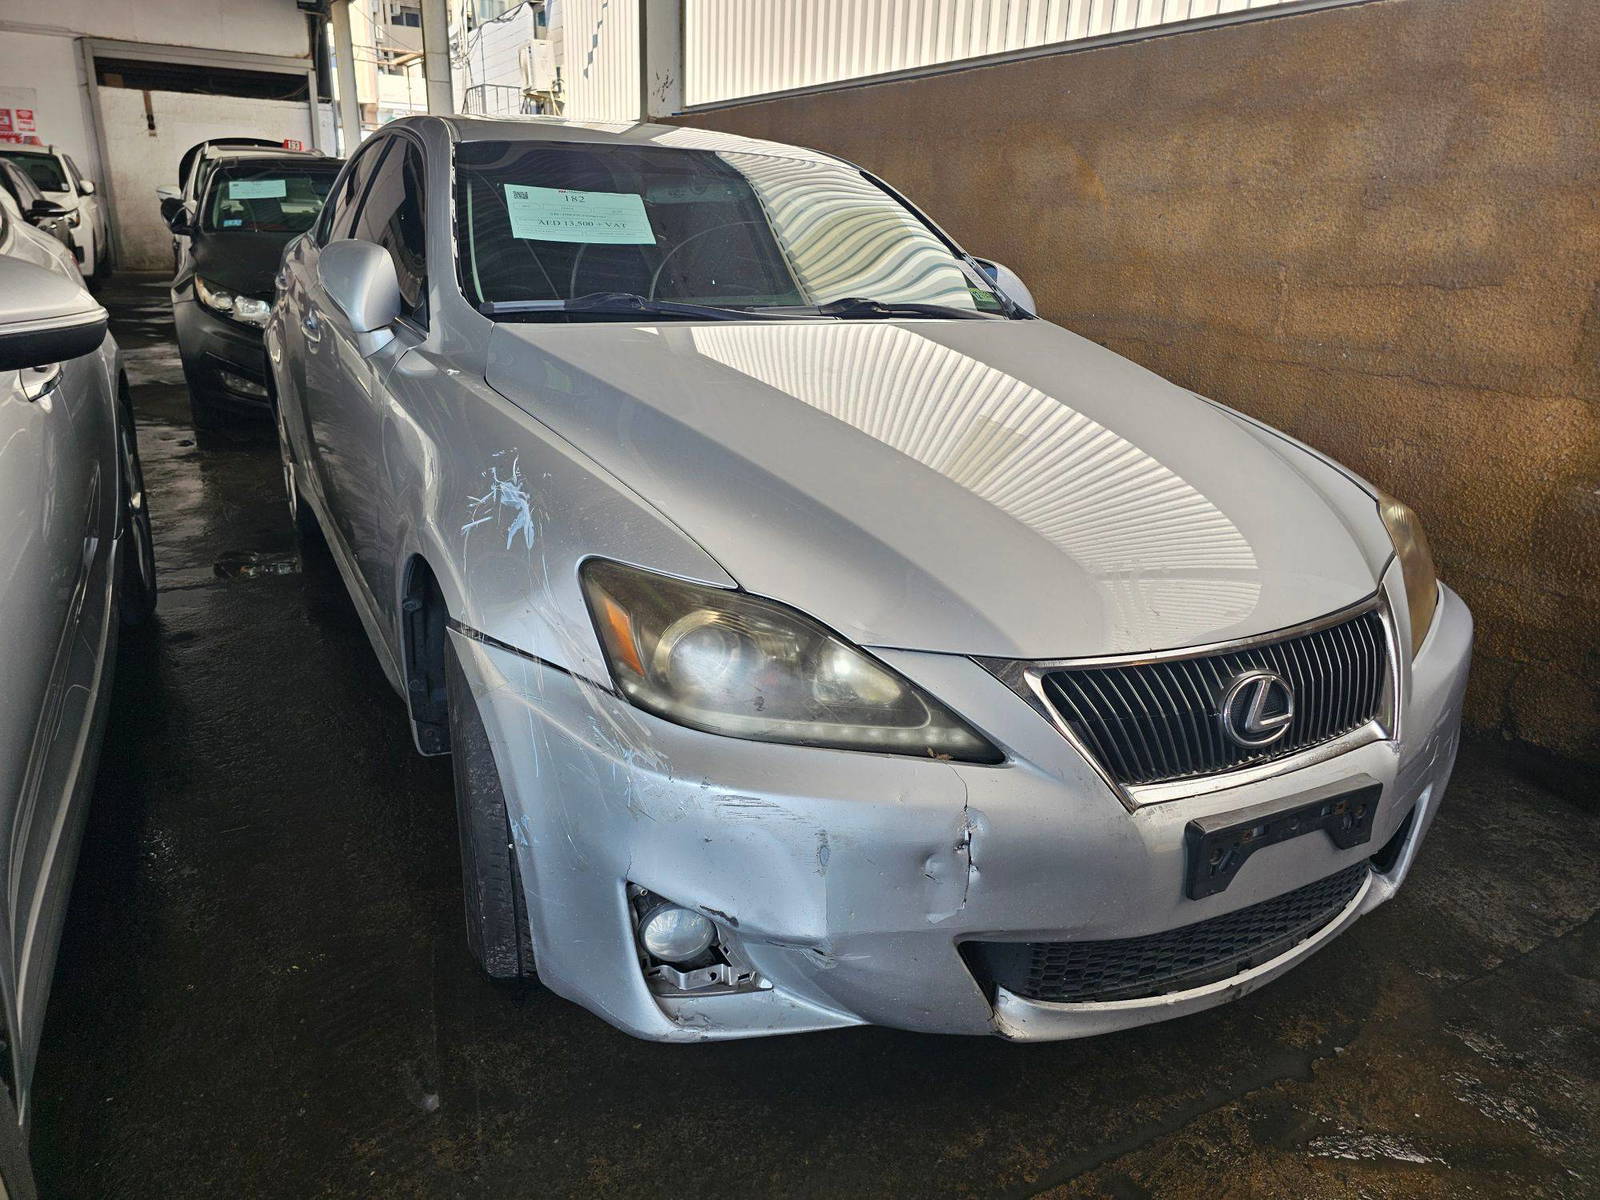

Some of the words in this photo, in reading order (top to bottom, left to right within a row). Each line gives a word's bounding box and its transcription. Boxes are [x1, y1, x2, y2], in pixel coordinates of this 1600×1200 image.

[565, 194, 585, 203] 182
[538, 219, 561, 227] AED
[564, 220, 594, 229] 13,500
[604, 221, 626, 229] VAT
